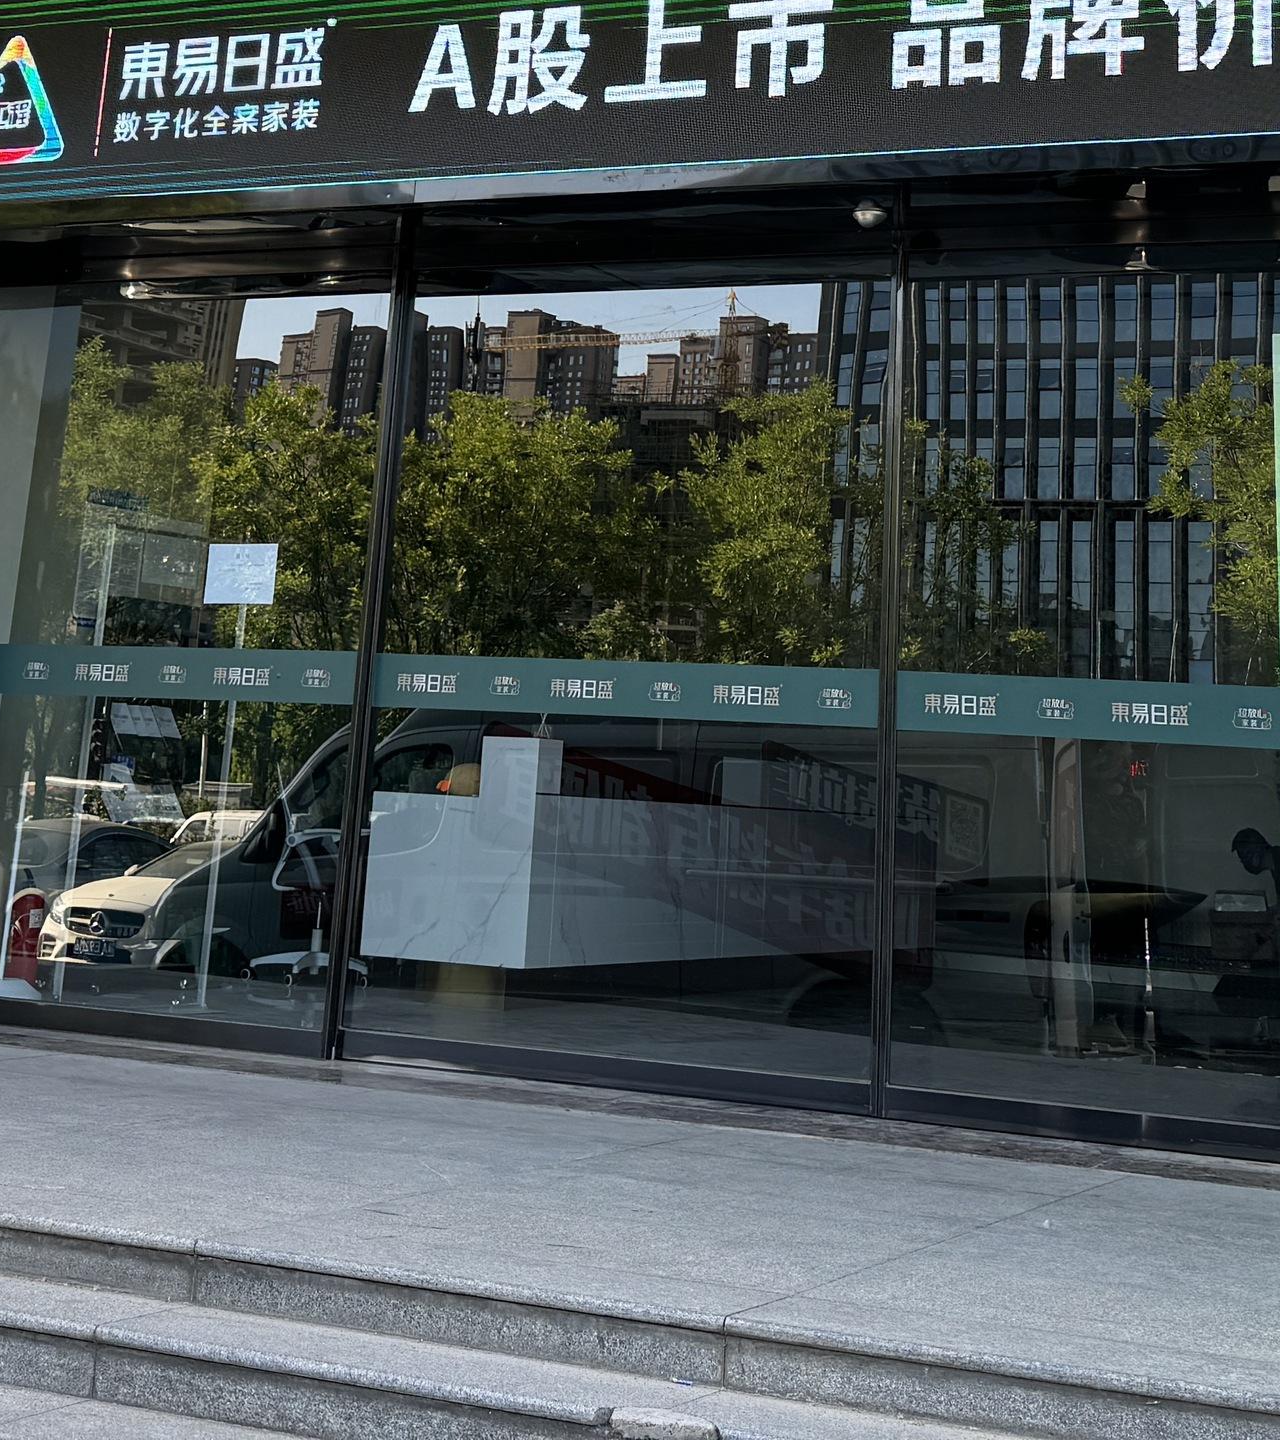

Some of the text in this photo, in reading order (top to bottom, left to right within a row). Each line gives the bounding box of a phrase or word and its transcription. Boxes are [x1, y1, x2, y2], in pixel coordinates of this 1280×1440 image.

[119, 27, 324, 100] 東易日盛
[114, 100, 319, 143] 数字化全案家装
[74, 664, 129, 682] 東易日盛
[213, 668, 270, 686] 東易日盛
[396, 674, 456, 693] 東易日盛
[550, 679, 613, 699] 東易日盛
[713, 685, 779, 706] 東易日盛
[924, 694, 996, 716] 東易日盛
[1111, 703, 1188, 725] 東易日盛
